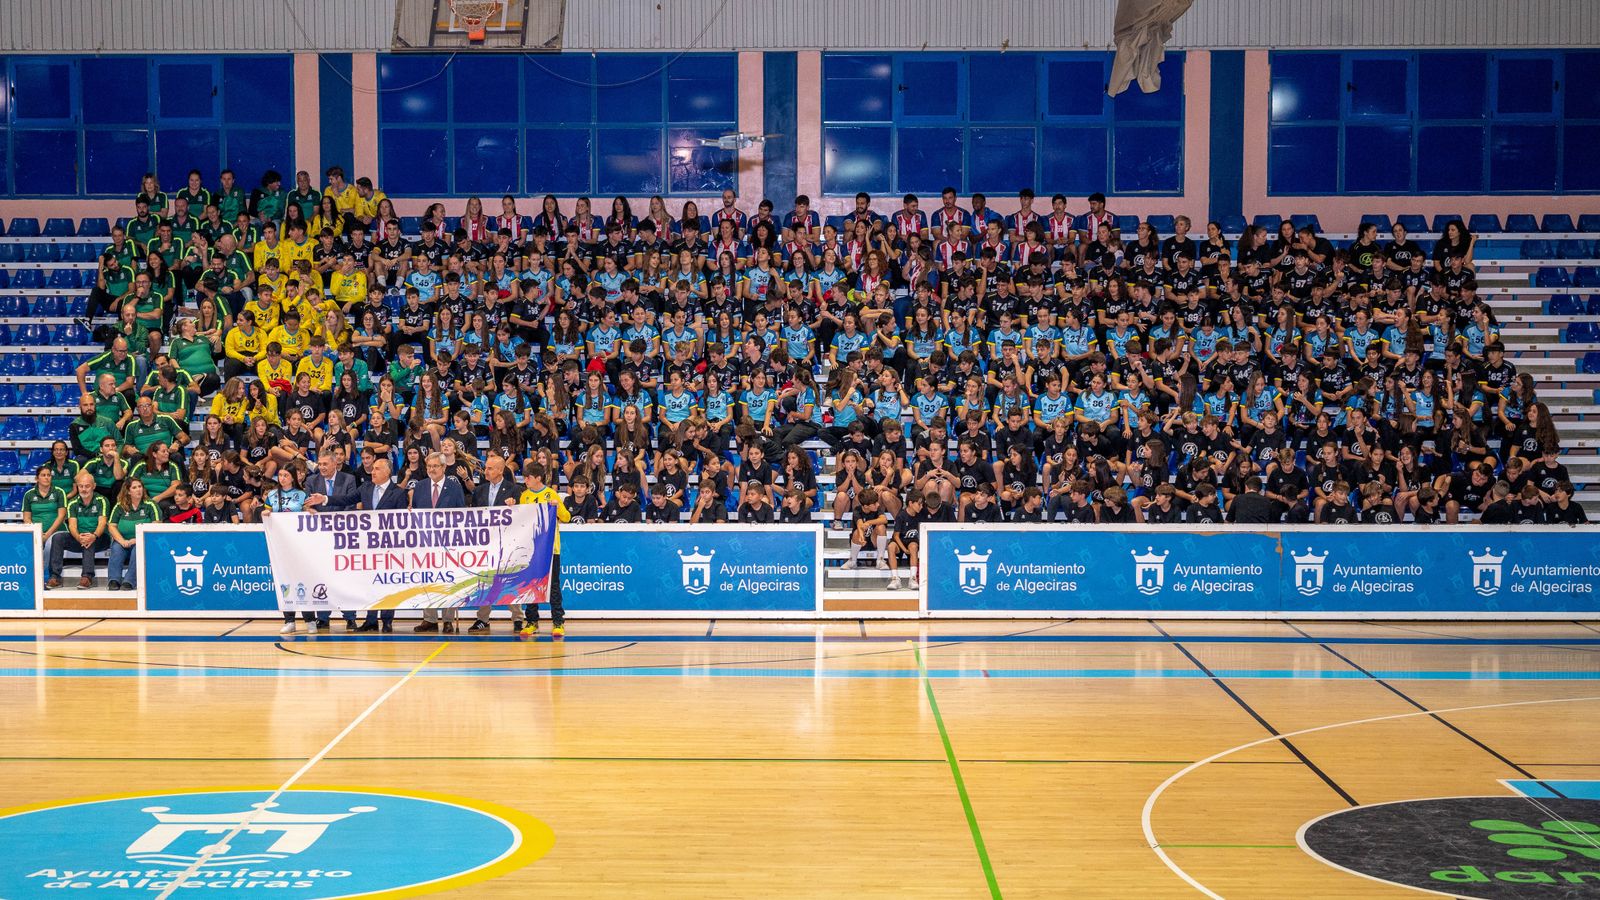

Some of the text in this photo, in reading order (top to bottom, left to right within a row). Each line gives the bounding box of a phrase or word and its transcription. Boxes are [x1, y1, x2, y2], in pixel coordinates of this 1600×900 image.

[297, 509, 513, 532] JUEGOS MUNICIPALES
[333, 527, 491, 550] DE BALONMANO
[334, 548, 488, 572] DELFÍN MUÑOZ
[720, 562, 808, 576] Ayuntamiento
[996, 562, 1086, 576] Ayuntamiento
[1173, 563, 1262, 577] Ayuntamiento
[1332, 564, 1423, 578] Ayuntamiento
[1511, 564, 1600, 578] Ayuntamiento
[372, 571, 455, 585] ALGECIRAS
[212, 580, 226, 592] de
[562, 579, 625, 594] Algeciras
[720, 579, 800, 594] de Algeciras
[996, 579, 1078, 594] de Algeciras
[1173, 580, 1254, 594] de Algeciras
[1332, 580, 1415, 595] de Algeciras
[1511, 580, 1593, 595] de Algeciras
[25, 868, 353, 880] Ayuntamiento
[43, 878, 314, 891] de Algeciras
